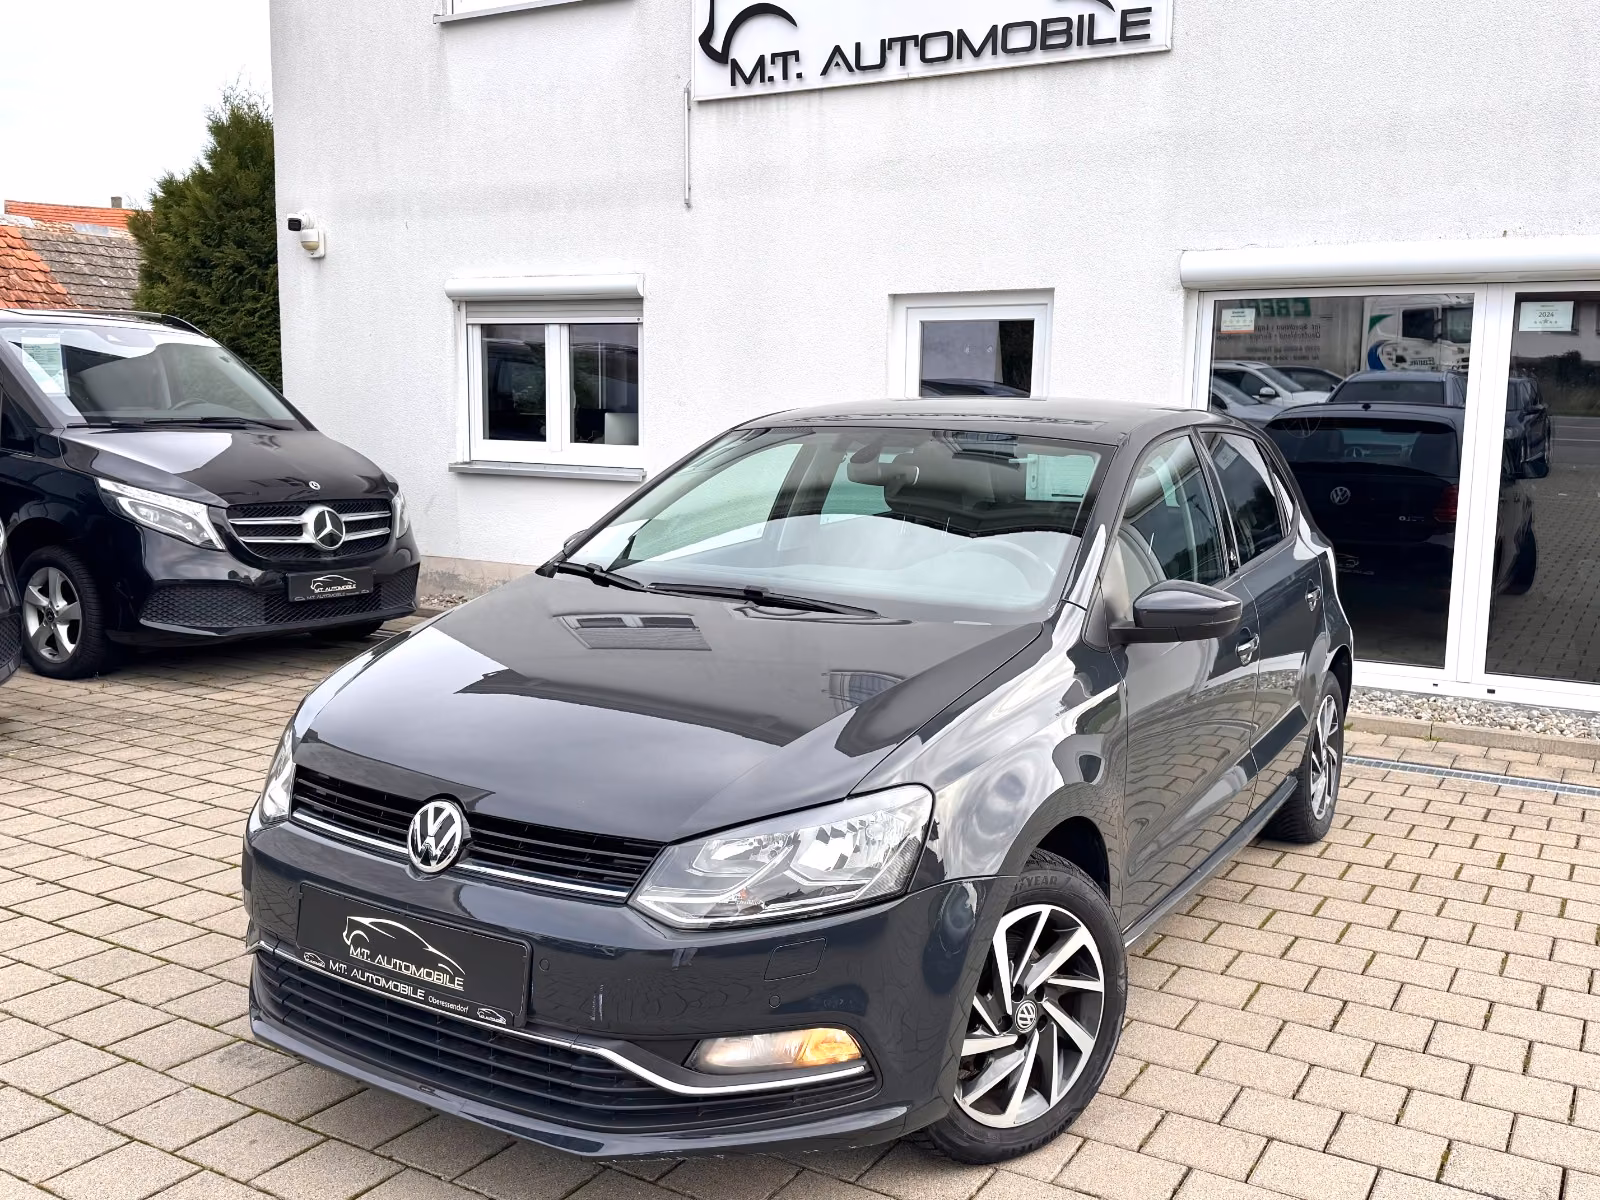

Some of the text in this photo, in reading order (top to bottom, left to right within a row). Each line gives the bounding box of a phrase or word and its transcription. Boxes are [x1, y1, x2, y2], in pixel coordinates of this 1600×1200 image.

[730, 7, 1152, 86] M.T. AUTOMOBILE
[329, 959, 348, 975] M.T.
[350, 968, 426, 1000] AUTOMOBILE
[428, 995, 469, 1014] Oberessendorf
[349, 944, 465, 991] M.T. AUTOMOBILE
